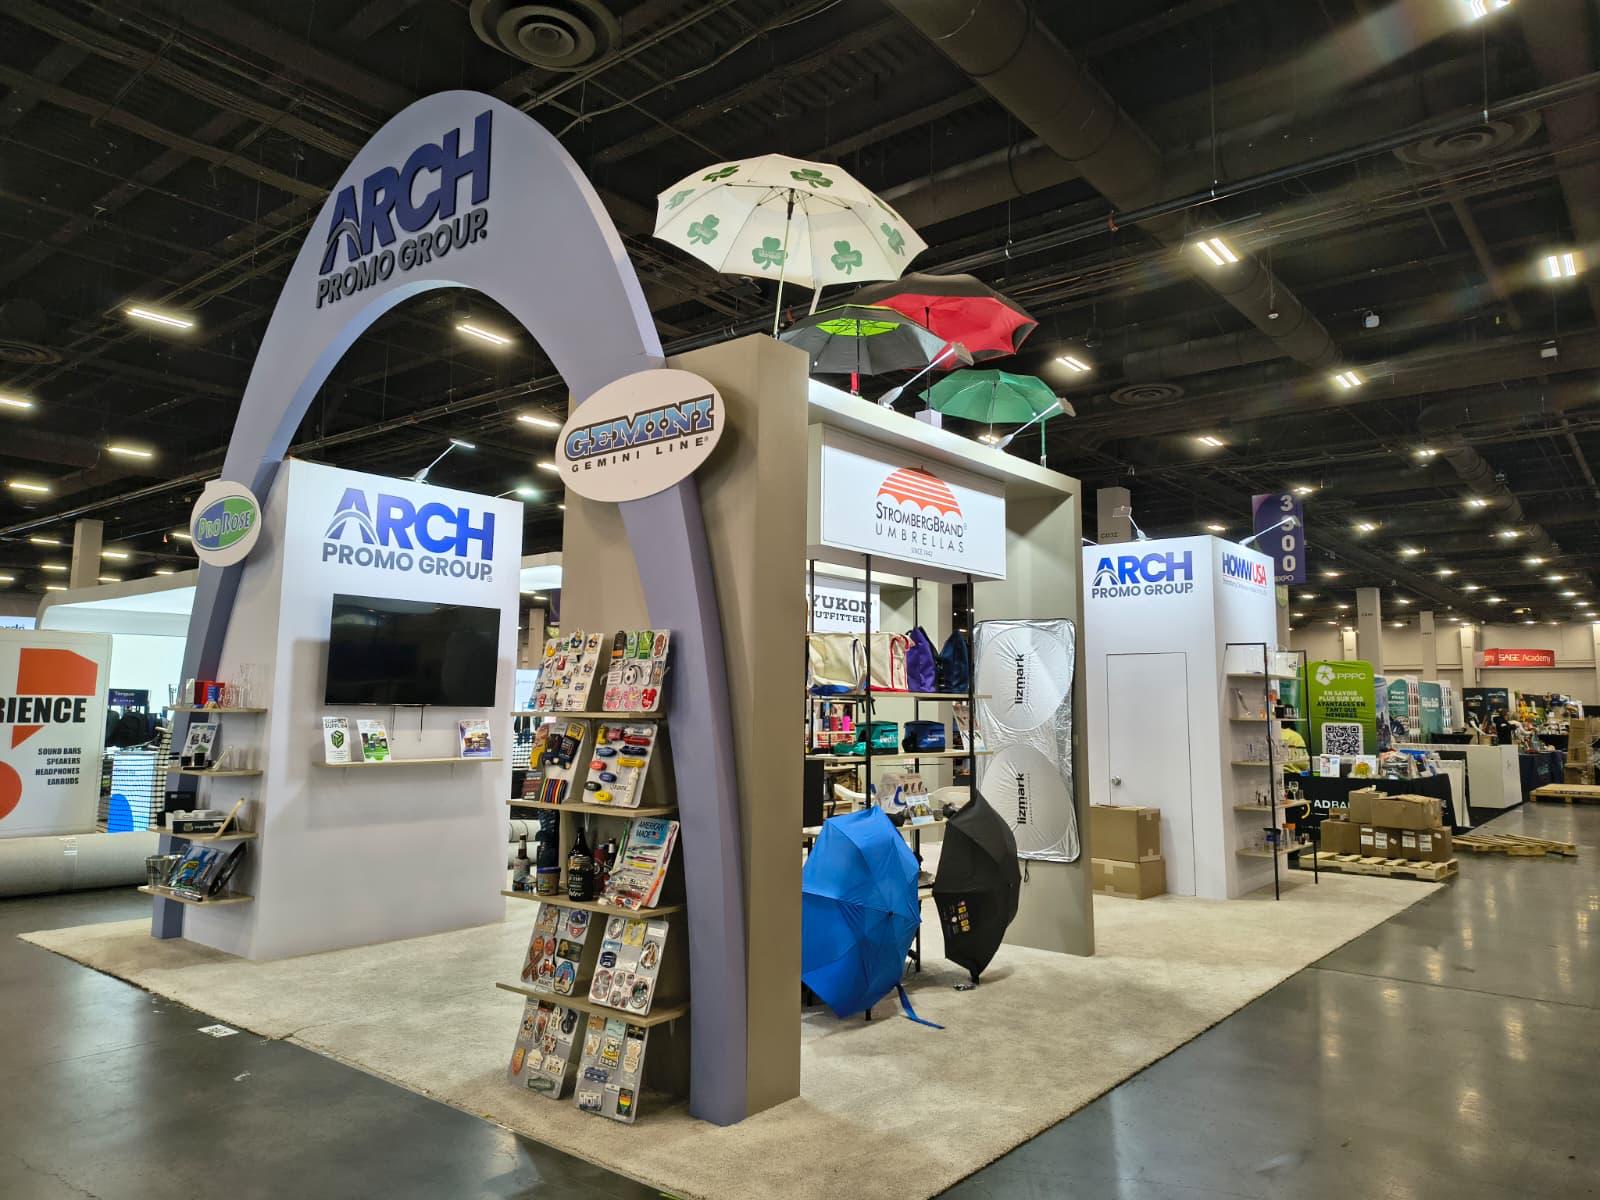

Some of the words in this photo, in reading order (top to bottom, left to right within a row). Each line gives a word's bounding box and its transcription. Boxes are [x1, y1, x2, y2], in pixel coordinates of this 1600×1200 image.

[319, 109, 493, 274] ARCH
[316, 249, 395, 308] PROMO
[399, 208, 488, 274] GROUP
[565, 394, 714, 460] GEMINI
[572, 451, 640, 472] GEMINI
[656, 436, 704, 455] LINE
[325, 488, 496, 560] ARCH
[875, 522, 964, 552] UMBRELLAS
[321, 542, 413, 571] PROMO
[418, 556, 493, 581] GROUP
[1092, 551, 1193, 586] ARCH
[1092, 586, 1141, 599] PROMO
[1144, 582, 1194, 596] GROUP
[808, 610, 871, 623] UTFITTER
[1499, 653, 1520, 662] SAGE
[1522, 653, 1551, 664] Academy
[1015, 654, 1025, 704] lizmark
[1337, 673, 1366, 681] PPPC
[38, 747, 62, 755] SOUND
[63, 747, 81, 755] BARS
[46, 757, 80, 765] SPEAKERS
[35, 767, 80, 776] HEADPHONES
[47, 777, 79, 786] EARBUDS
[1016, 773, 1028, 825] lizmark
